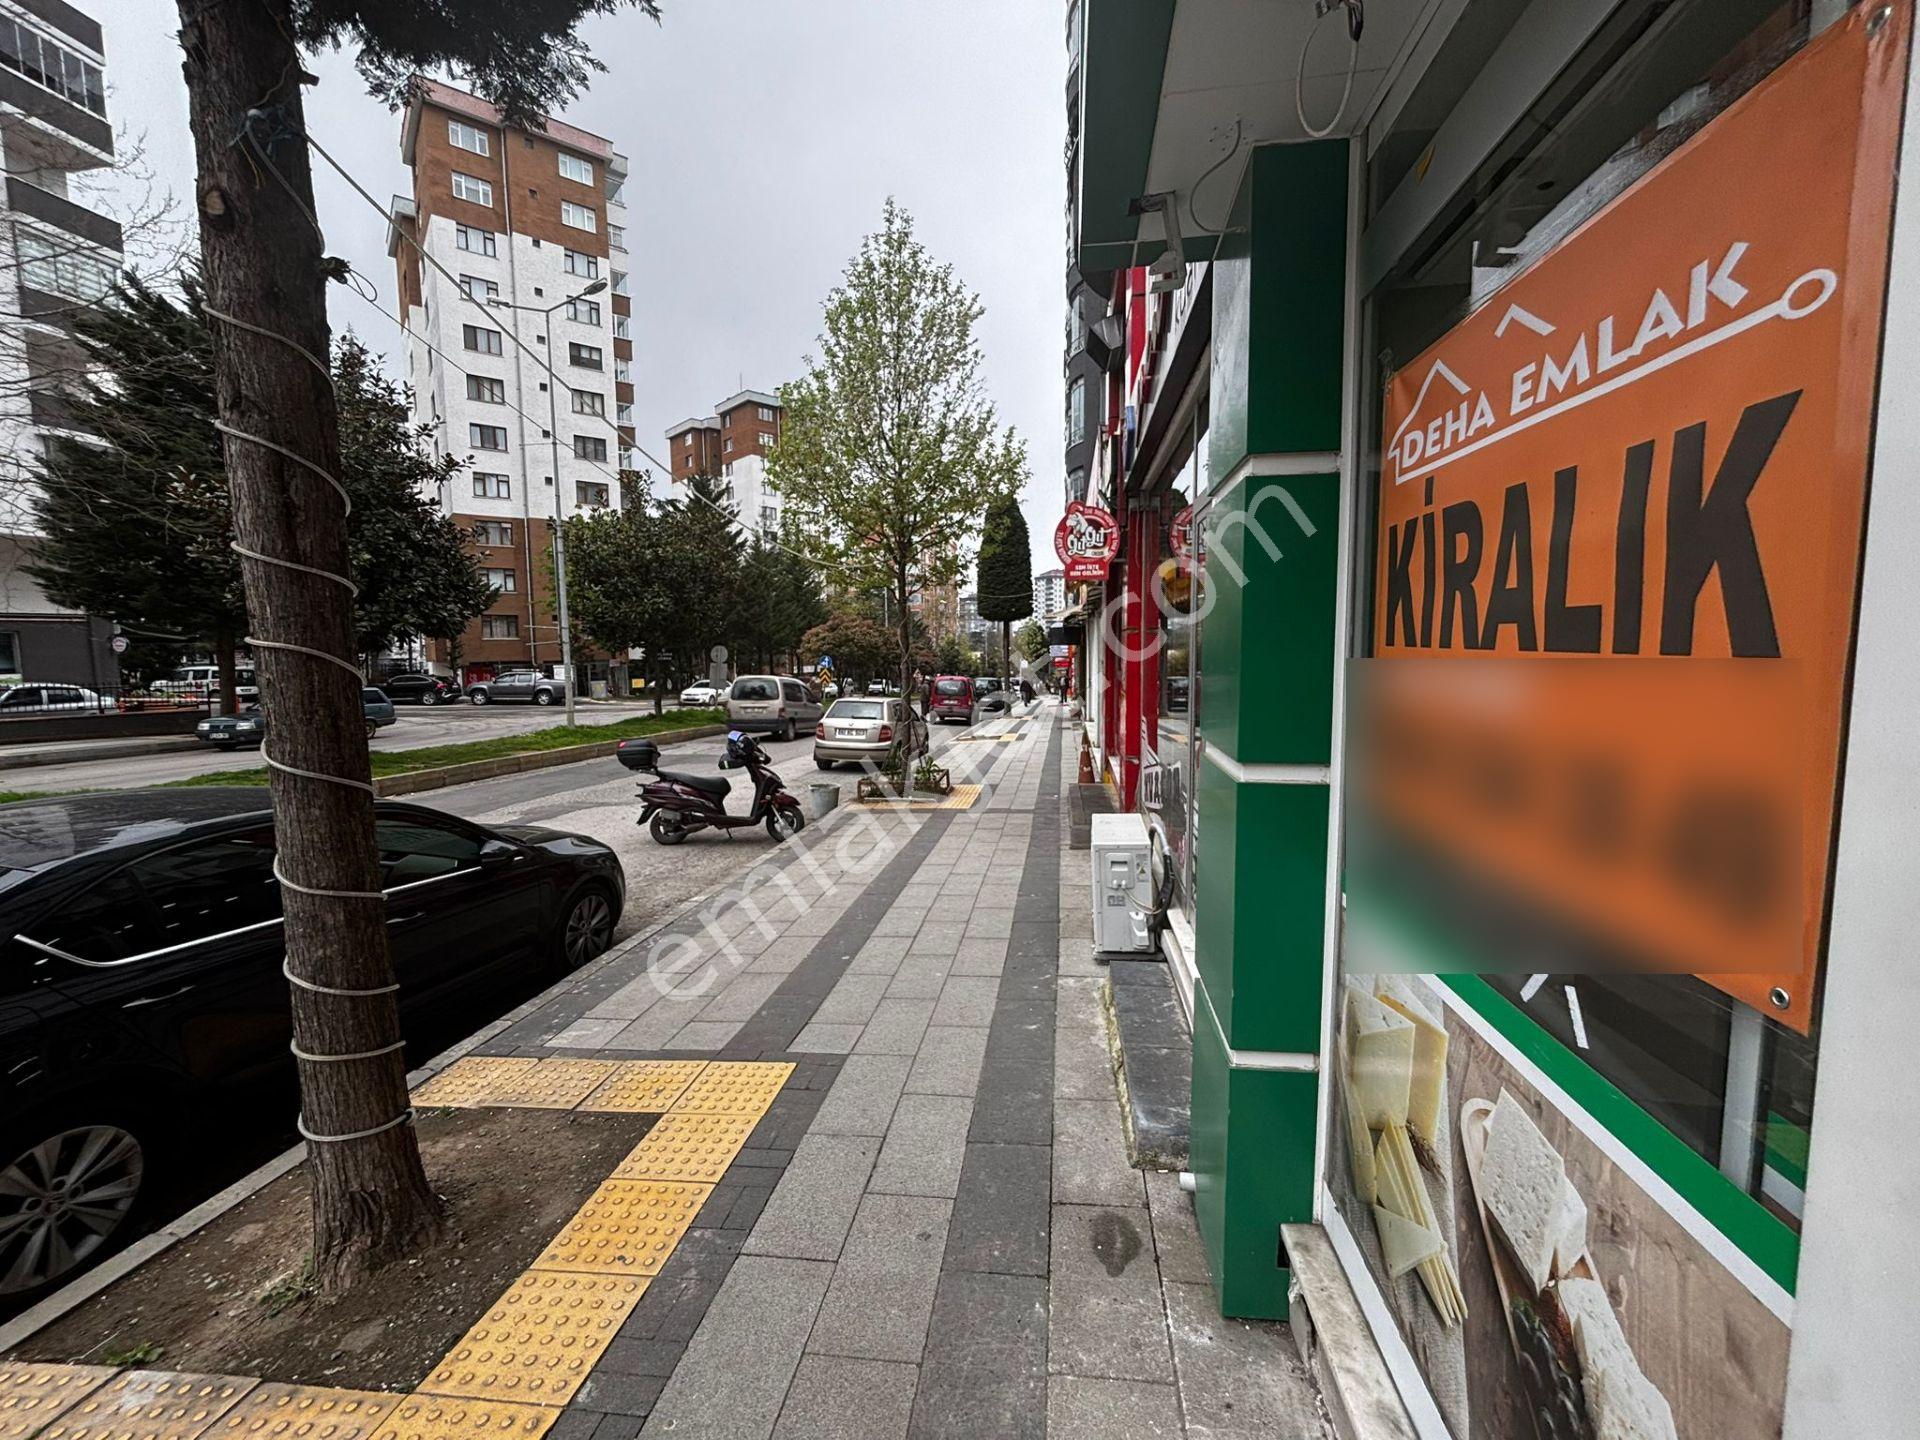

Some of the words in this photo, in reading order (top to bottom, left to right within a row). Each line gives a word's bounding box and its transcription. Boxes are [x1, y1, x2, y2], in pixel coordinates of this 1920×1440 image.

[1403, 391, 1496, 468] DEHA
[1511, 242, 1750, 416] EMLAK
[1386, 389, 1804, 658] KİRALIK
